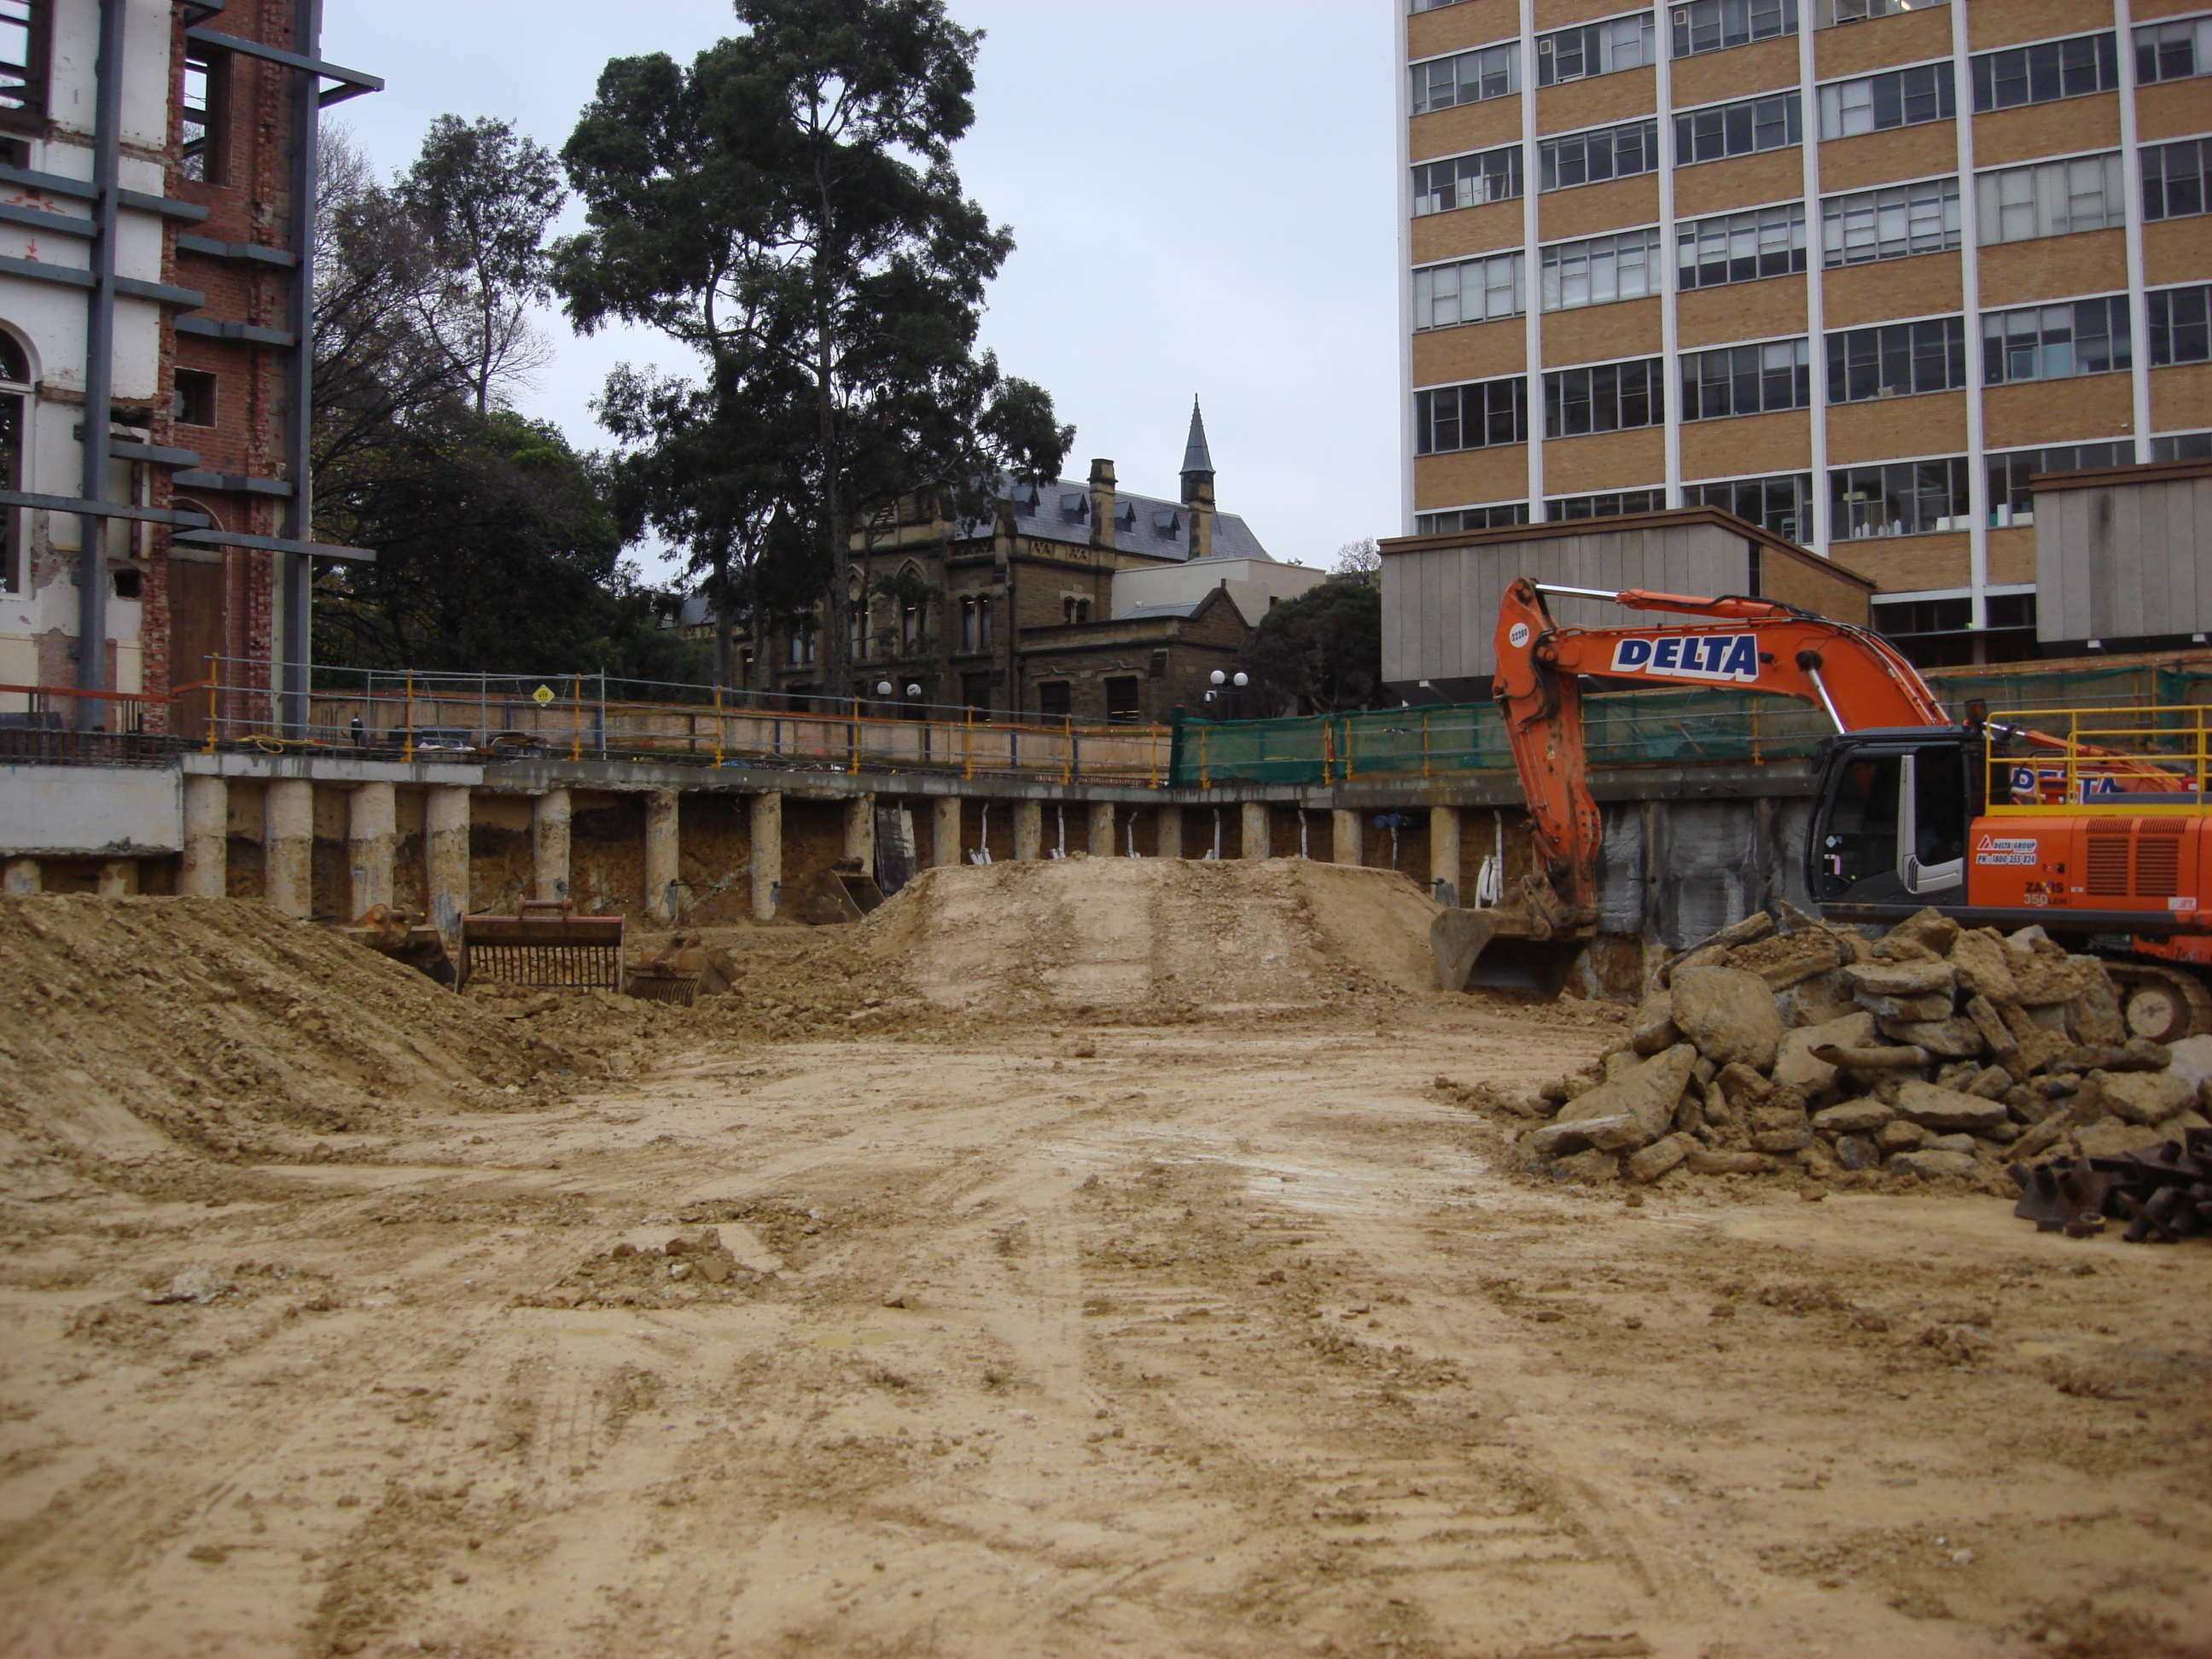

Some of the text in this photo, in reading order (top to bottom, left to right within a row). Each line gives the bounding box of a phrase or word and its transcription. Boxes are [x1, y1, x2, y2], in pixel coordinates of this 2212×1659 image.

[1616, 635, 1758, 678] DELTA
[2011, 768, 2118, 803] DTA
[1993, 854, 2007, 863] 1800
